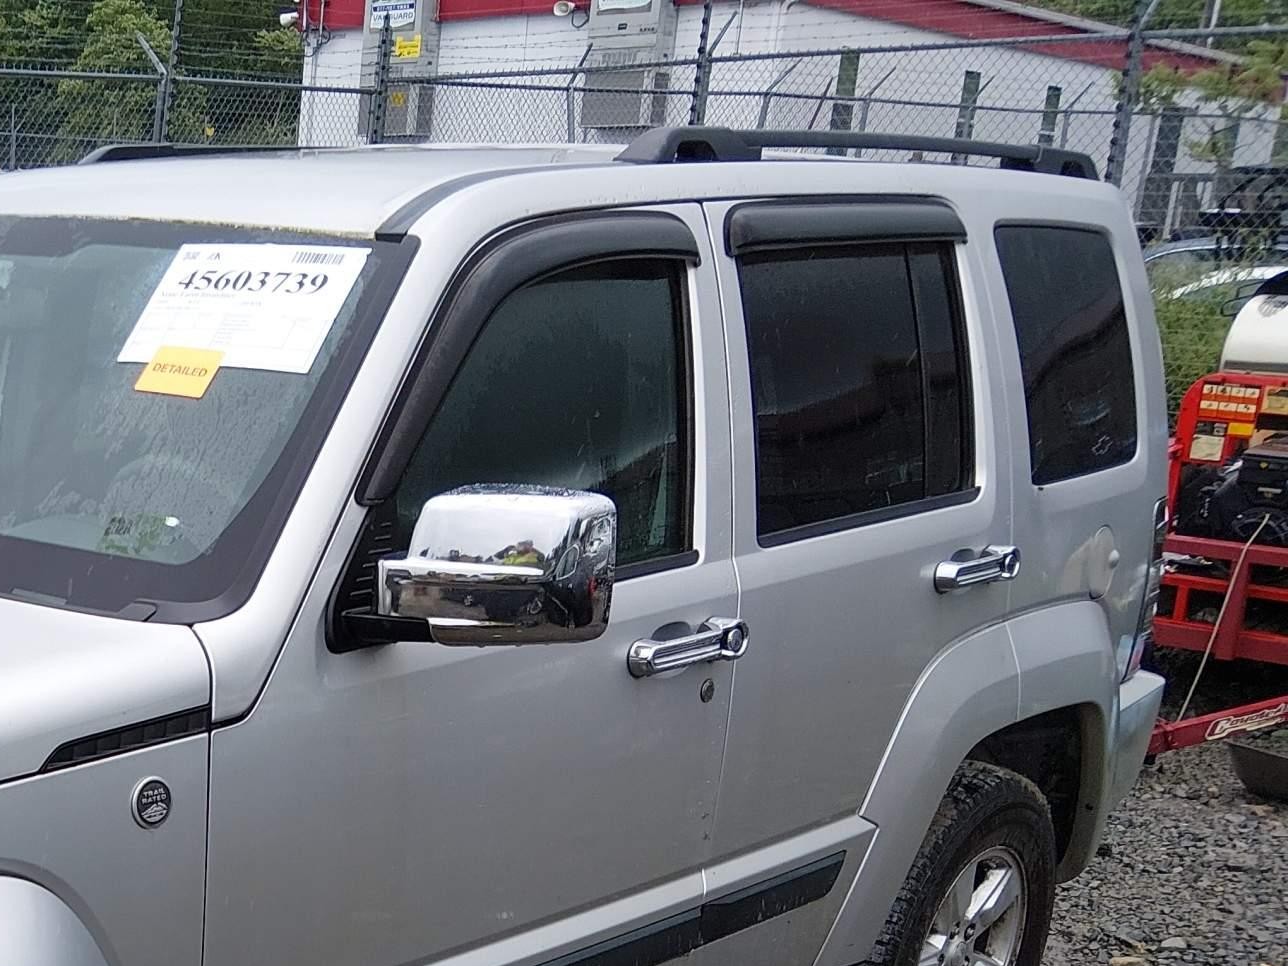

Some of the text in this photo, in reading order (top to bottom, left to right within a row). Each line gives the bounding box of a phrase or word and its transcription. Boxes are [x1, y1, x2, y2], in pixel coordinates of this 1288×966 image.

[177, 270, 329, 296] 45603739
[152, 362, 208, 378] DETAILED
[143, 787, 166, 798] TRAIL
[141, 794, 167, 805] RATED
